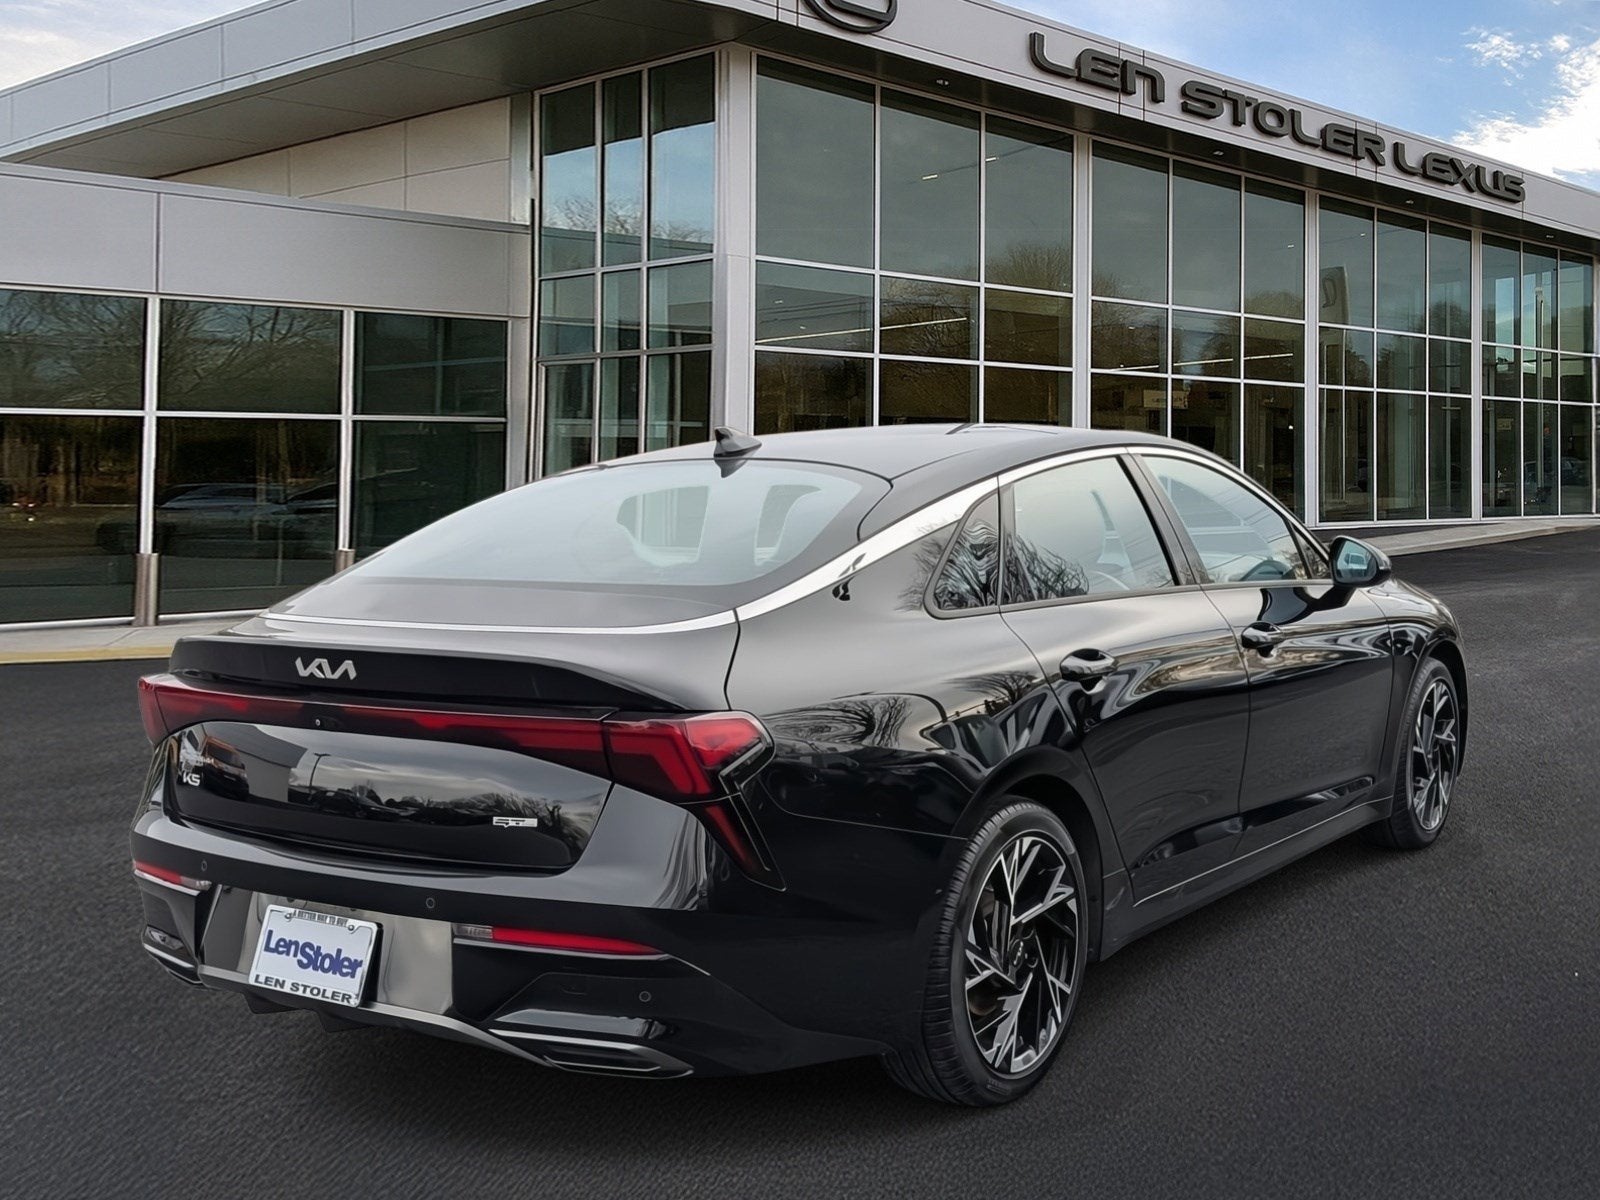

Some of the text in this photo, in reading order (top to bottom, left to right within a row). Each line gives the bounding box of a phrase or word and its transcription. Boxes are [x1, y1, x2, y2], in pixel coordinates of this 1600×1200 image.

[1029, 32, 1526, 203] LEN STOLER LEXUS
[295, 656, 357, 680] KIA
[254, 974, 352, 1004] LEN STOLER
